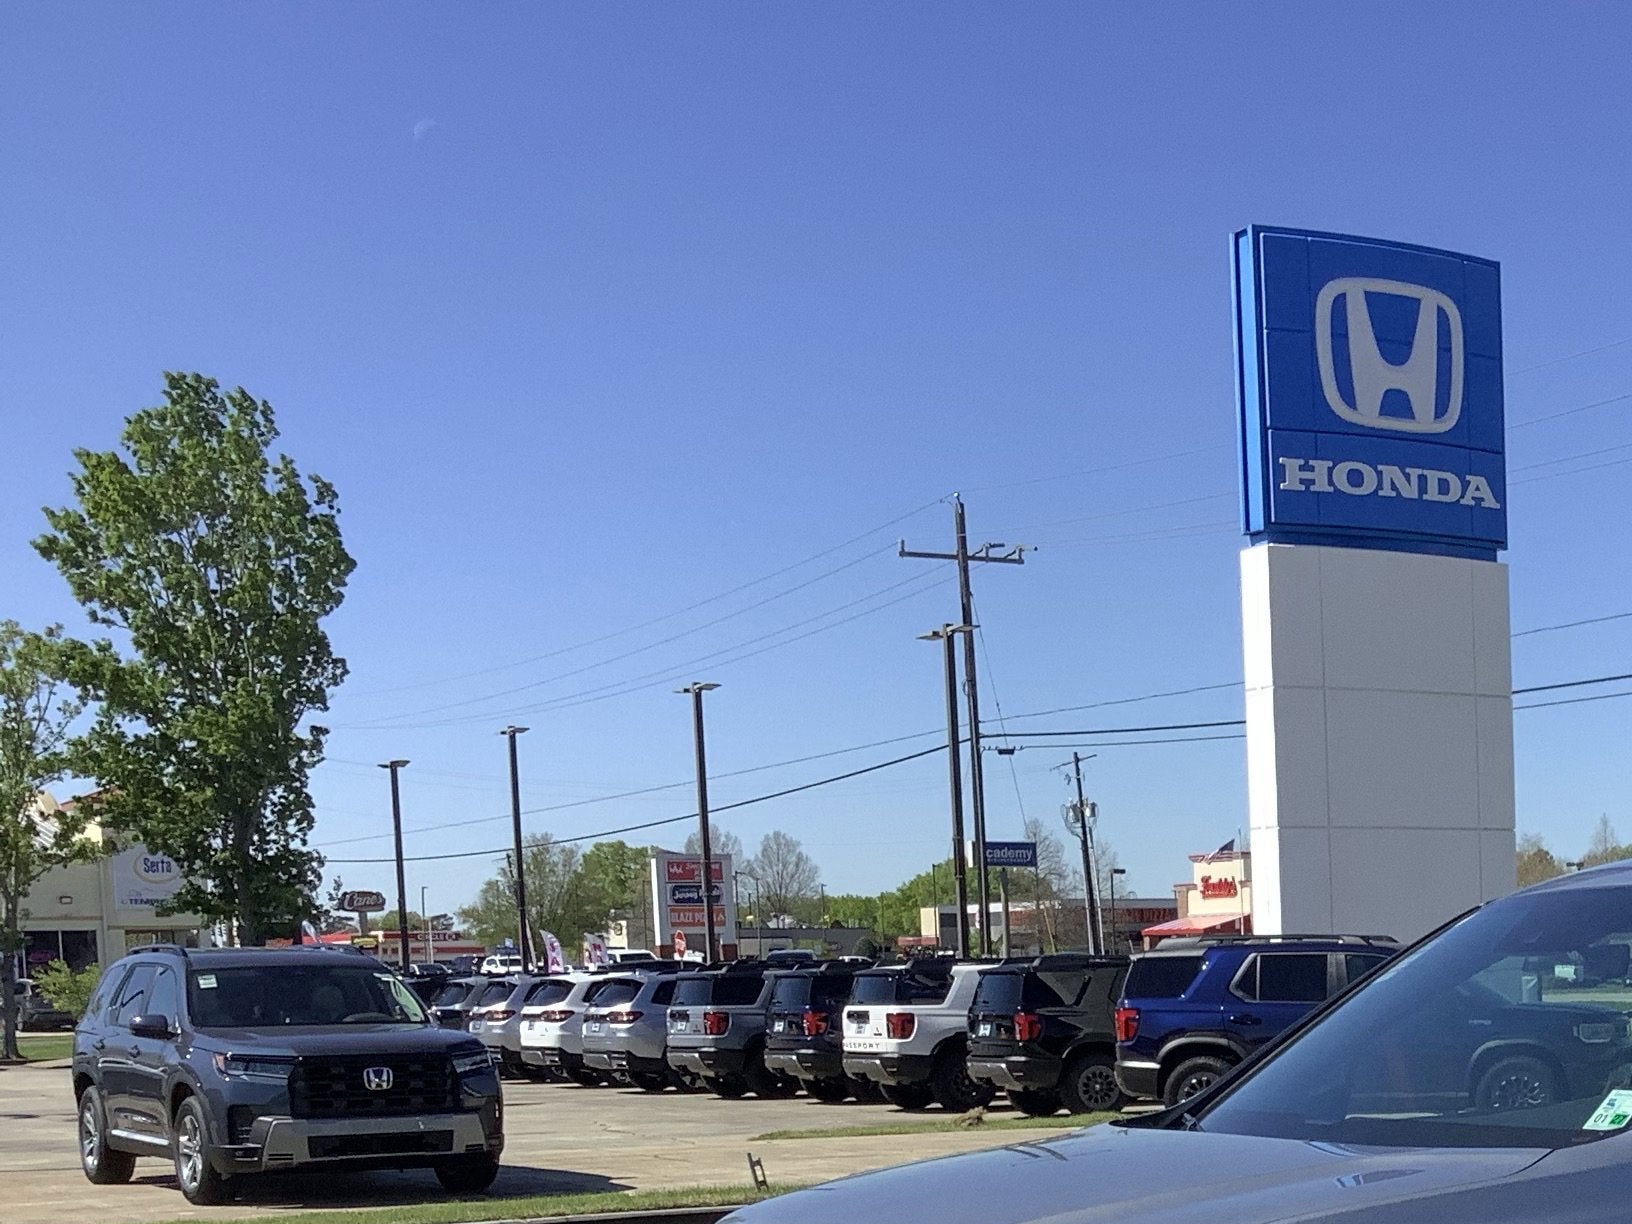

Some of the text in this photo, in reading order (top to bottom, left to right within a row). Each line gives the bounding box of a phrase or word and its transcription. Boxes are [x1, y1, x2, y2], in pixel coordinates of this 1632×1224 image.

[1279, 456, 1501, 509] HONDA
[985, 846, 1033, 861] cademy
[143, 857, 172, 874] Serta
[671, 912, 692, 923] BLAZE
[1594, 1113, 1627, 1125] 01 27
